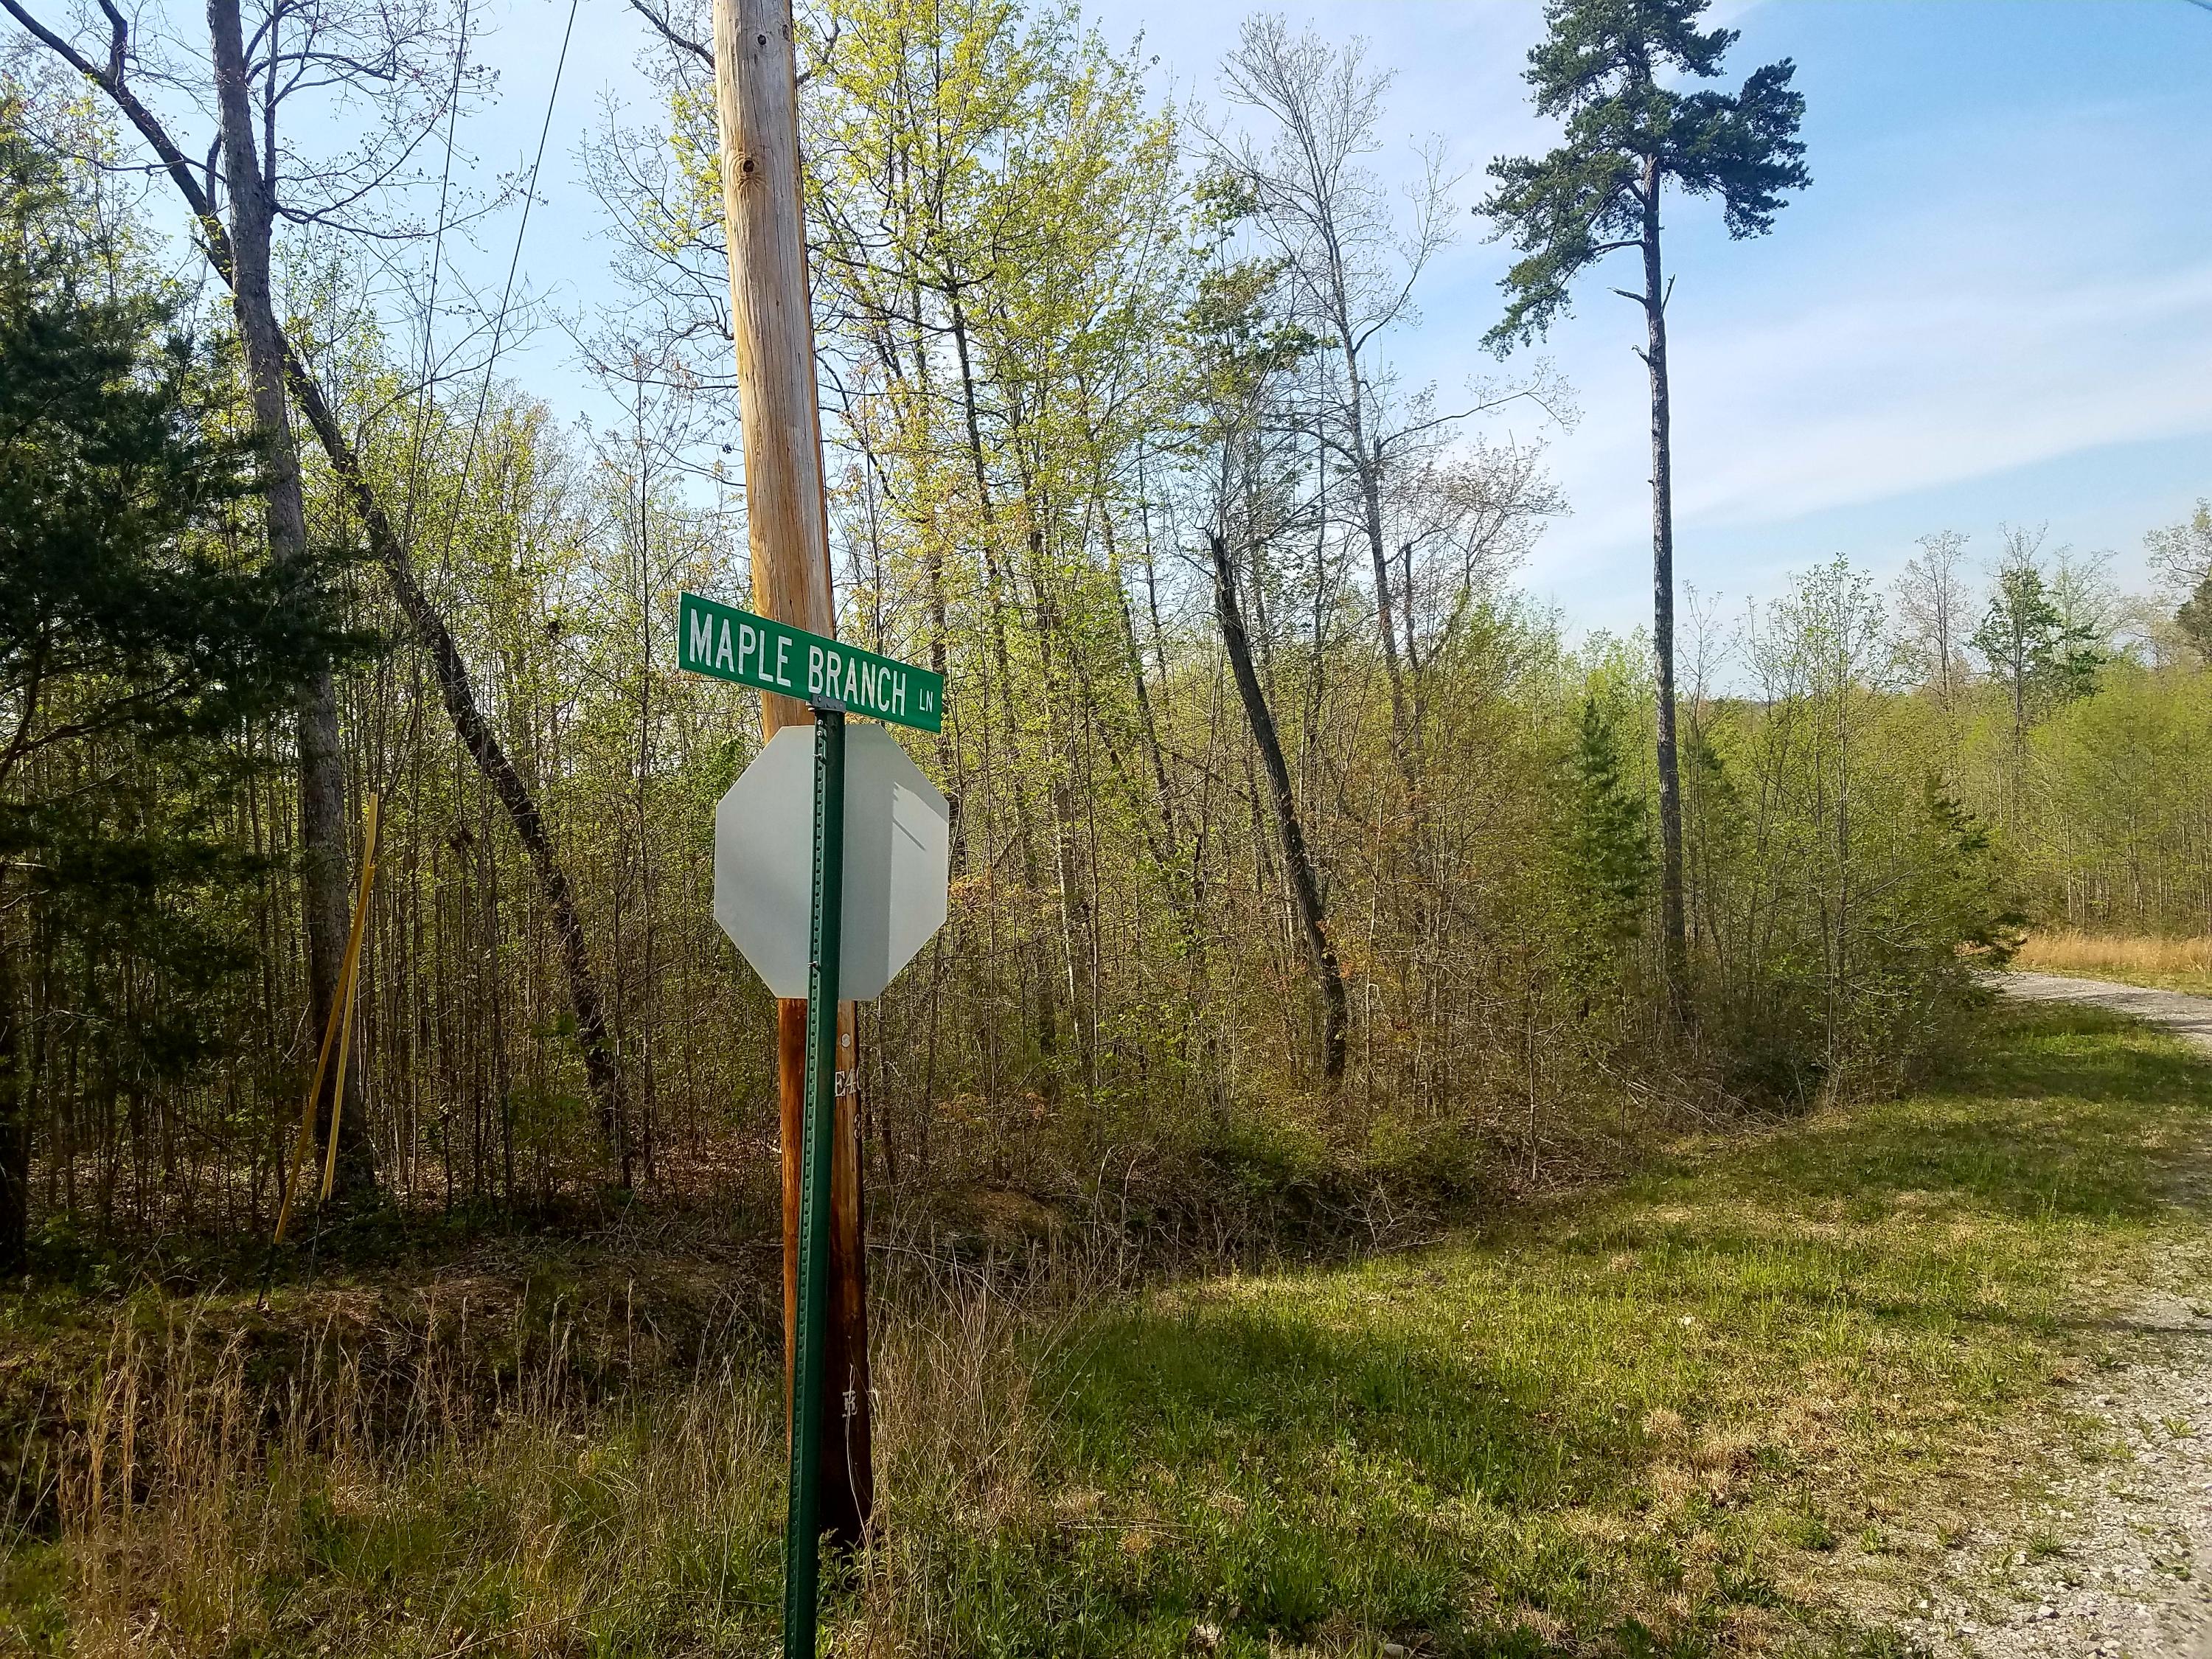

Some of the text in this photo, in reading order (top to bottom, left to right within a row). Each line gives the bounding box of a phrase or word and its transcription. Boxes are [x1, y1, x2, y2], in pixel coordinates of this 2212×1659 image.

[689, 608, 933, 716] MAPLE BRANCH LN
